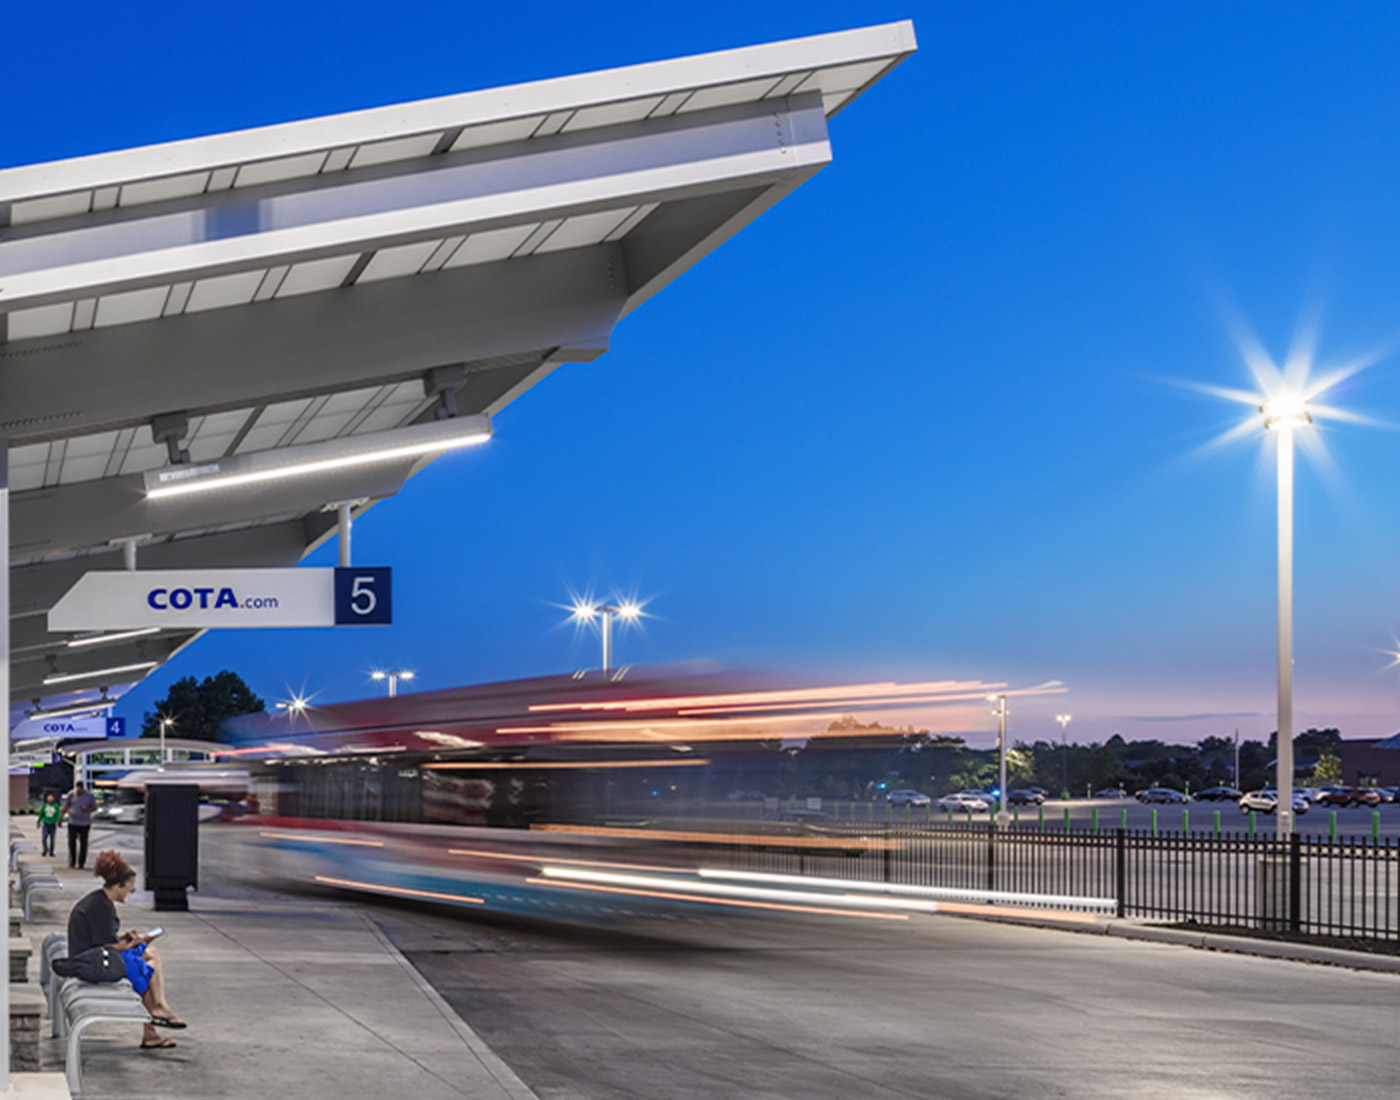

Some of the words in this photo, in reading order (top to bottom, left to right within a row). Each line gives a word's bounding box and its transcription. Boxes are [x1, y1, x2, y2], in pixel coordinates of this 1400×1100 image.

[147, 587, 279, 610] COTA.com
[351, 576, 377, 615] 5
[111, 721, 121, 734] 4
